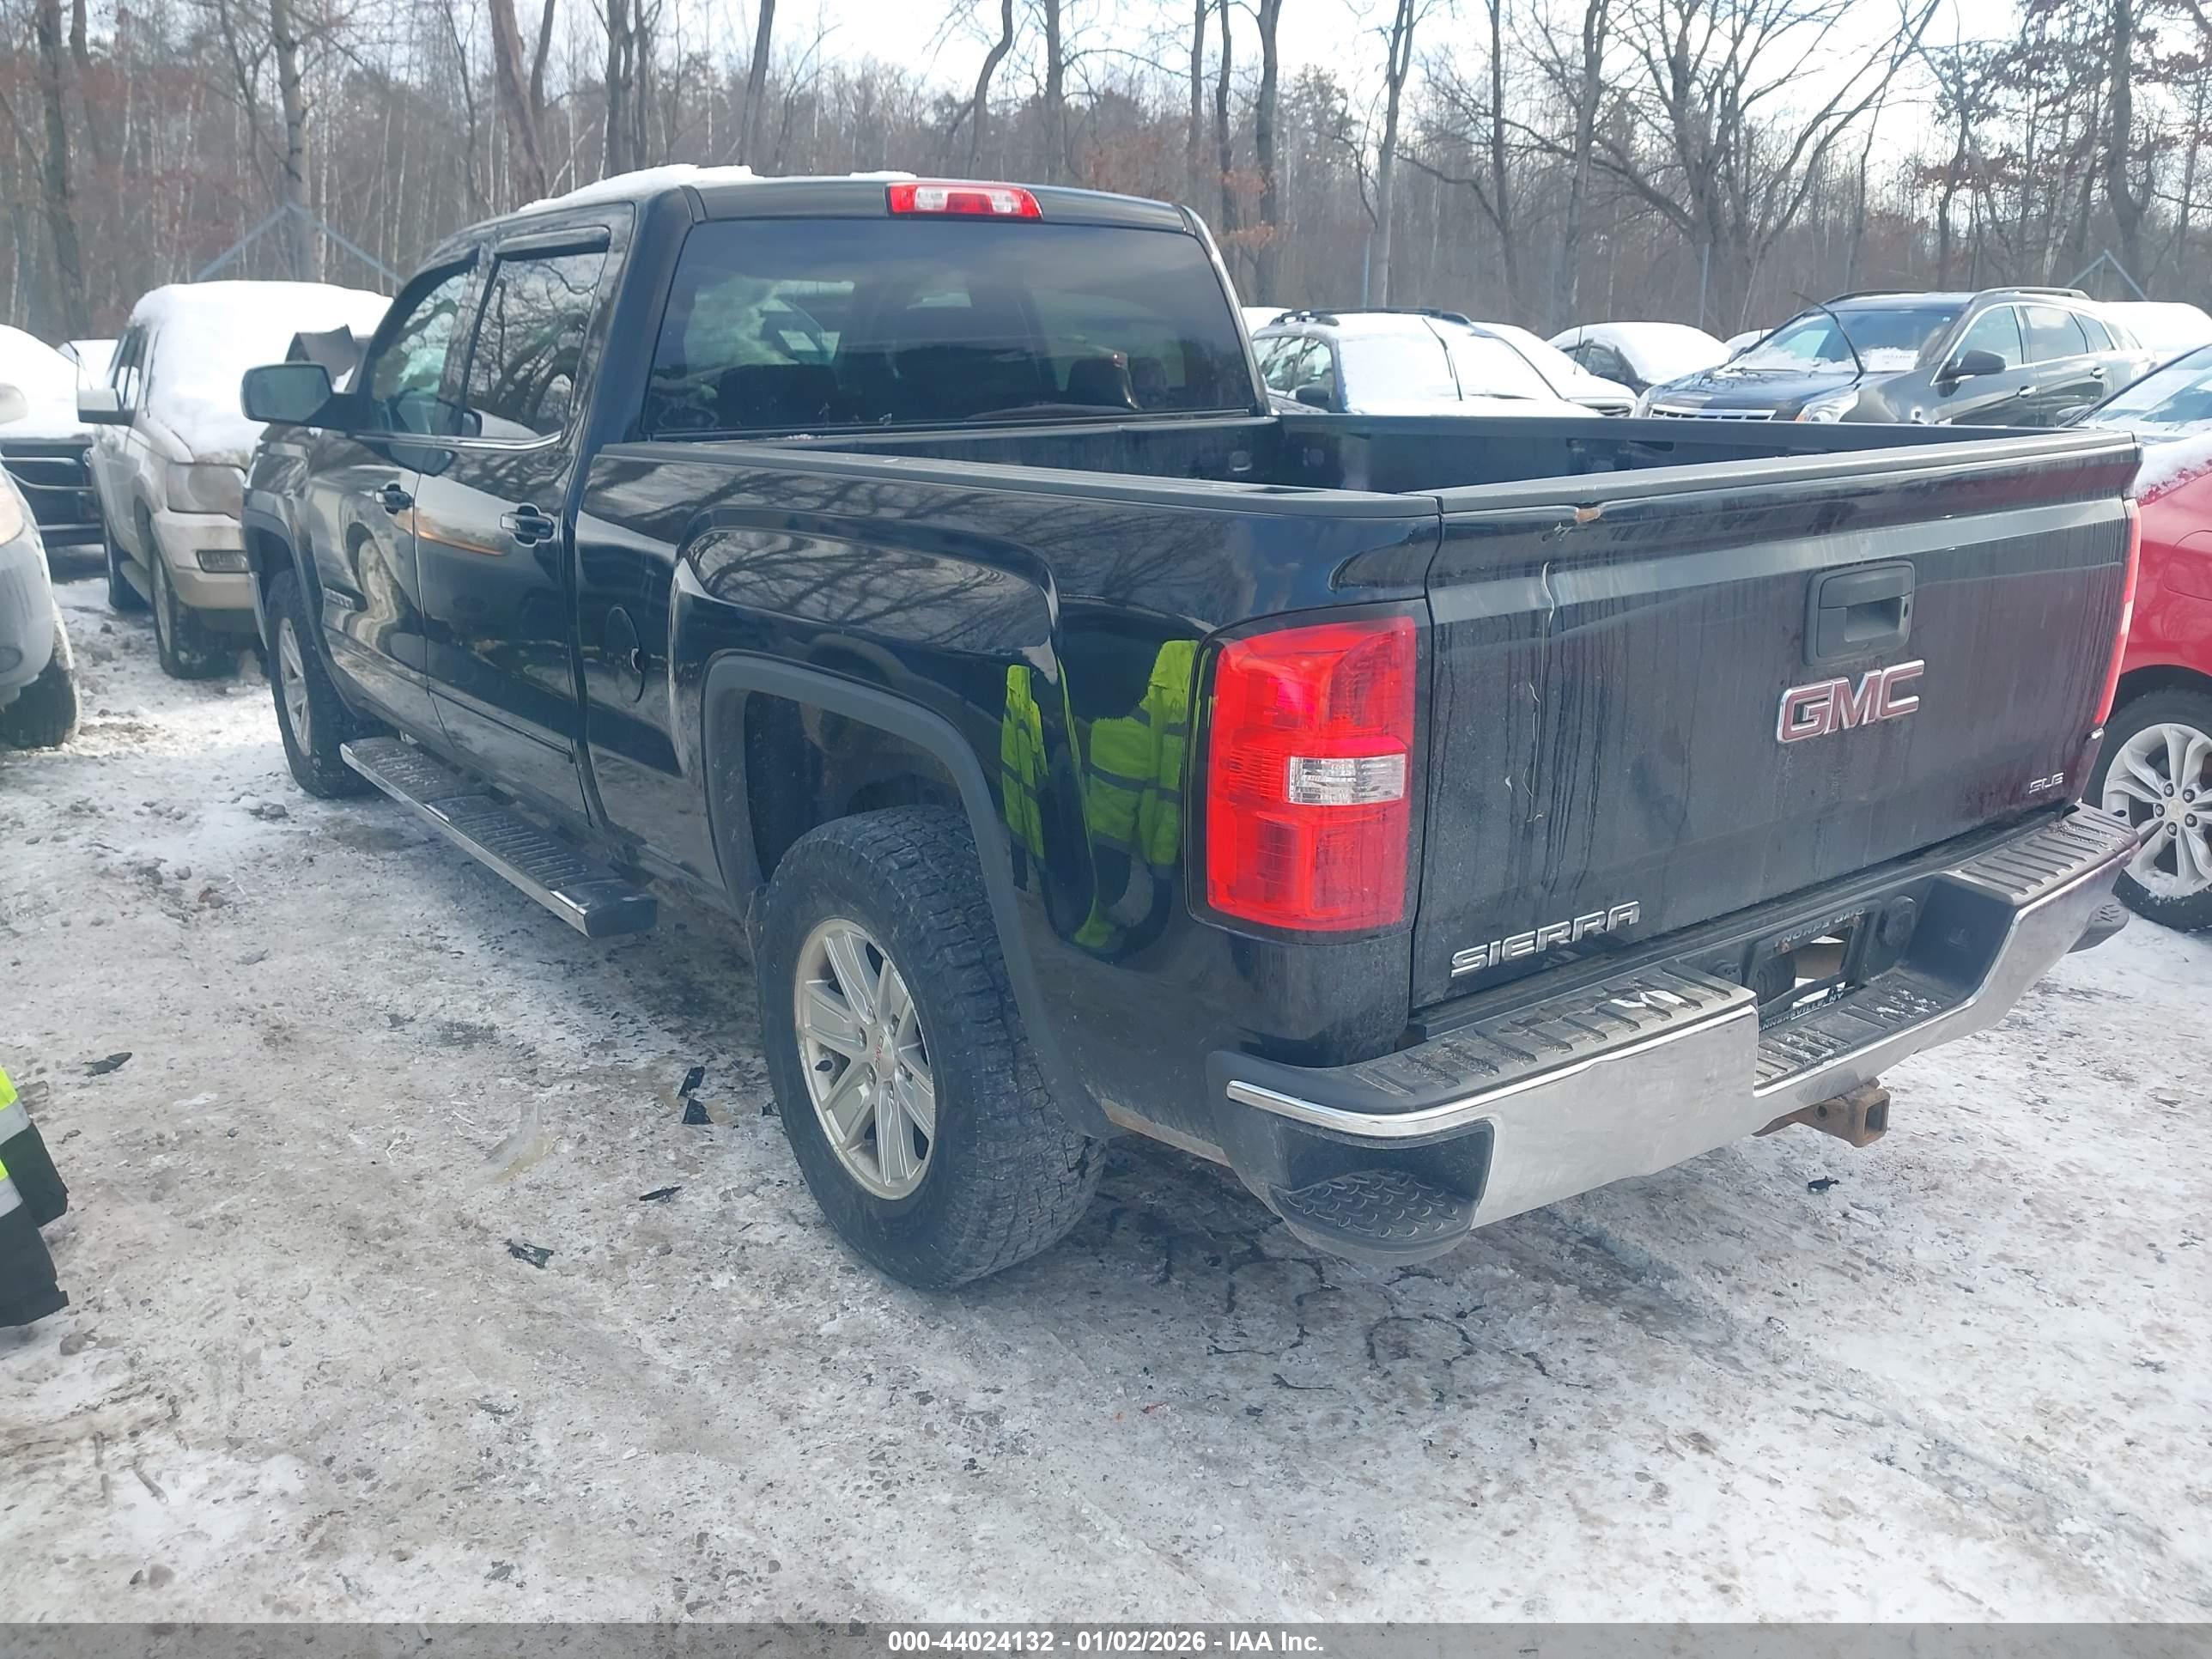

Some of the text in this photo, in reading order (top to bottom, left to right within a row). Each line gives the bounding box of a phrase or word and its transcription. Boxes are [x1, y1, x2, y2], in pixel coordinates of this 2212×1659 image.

[1777, 659, 1925, 744] GMC
[2028, 772, 2064, 794] SLE
[1450, 900, 1640, 978] SIERRA
